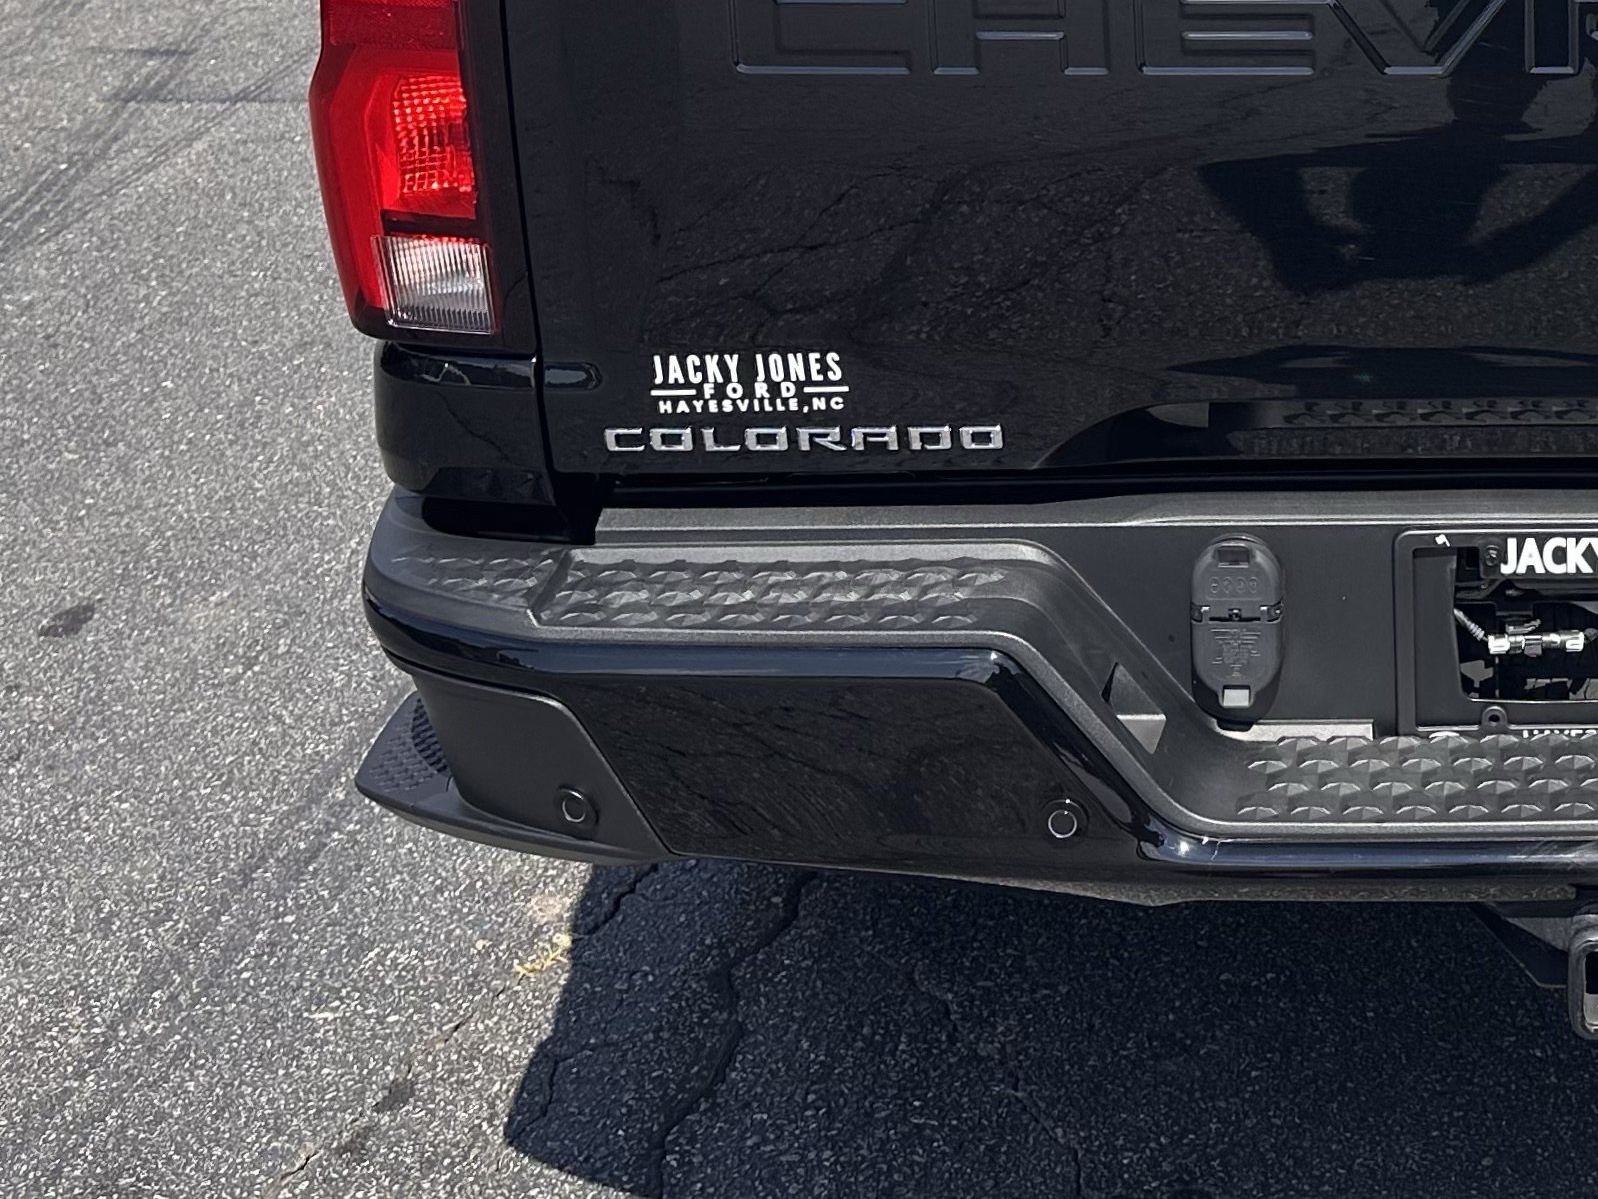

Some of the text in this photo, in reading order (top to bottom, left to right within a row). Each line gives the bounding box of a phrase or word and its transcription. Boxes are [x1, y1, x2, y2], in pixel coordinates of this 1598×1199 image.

[653, 351, 842, 384] JACKY JONES
[702, 381, 796, 399] FORD
[603, 424, 1005, 452] COLORADO
